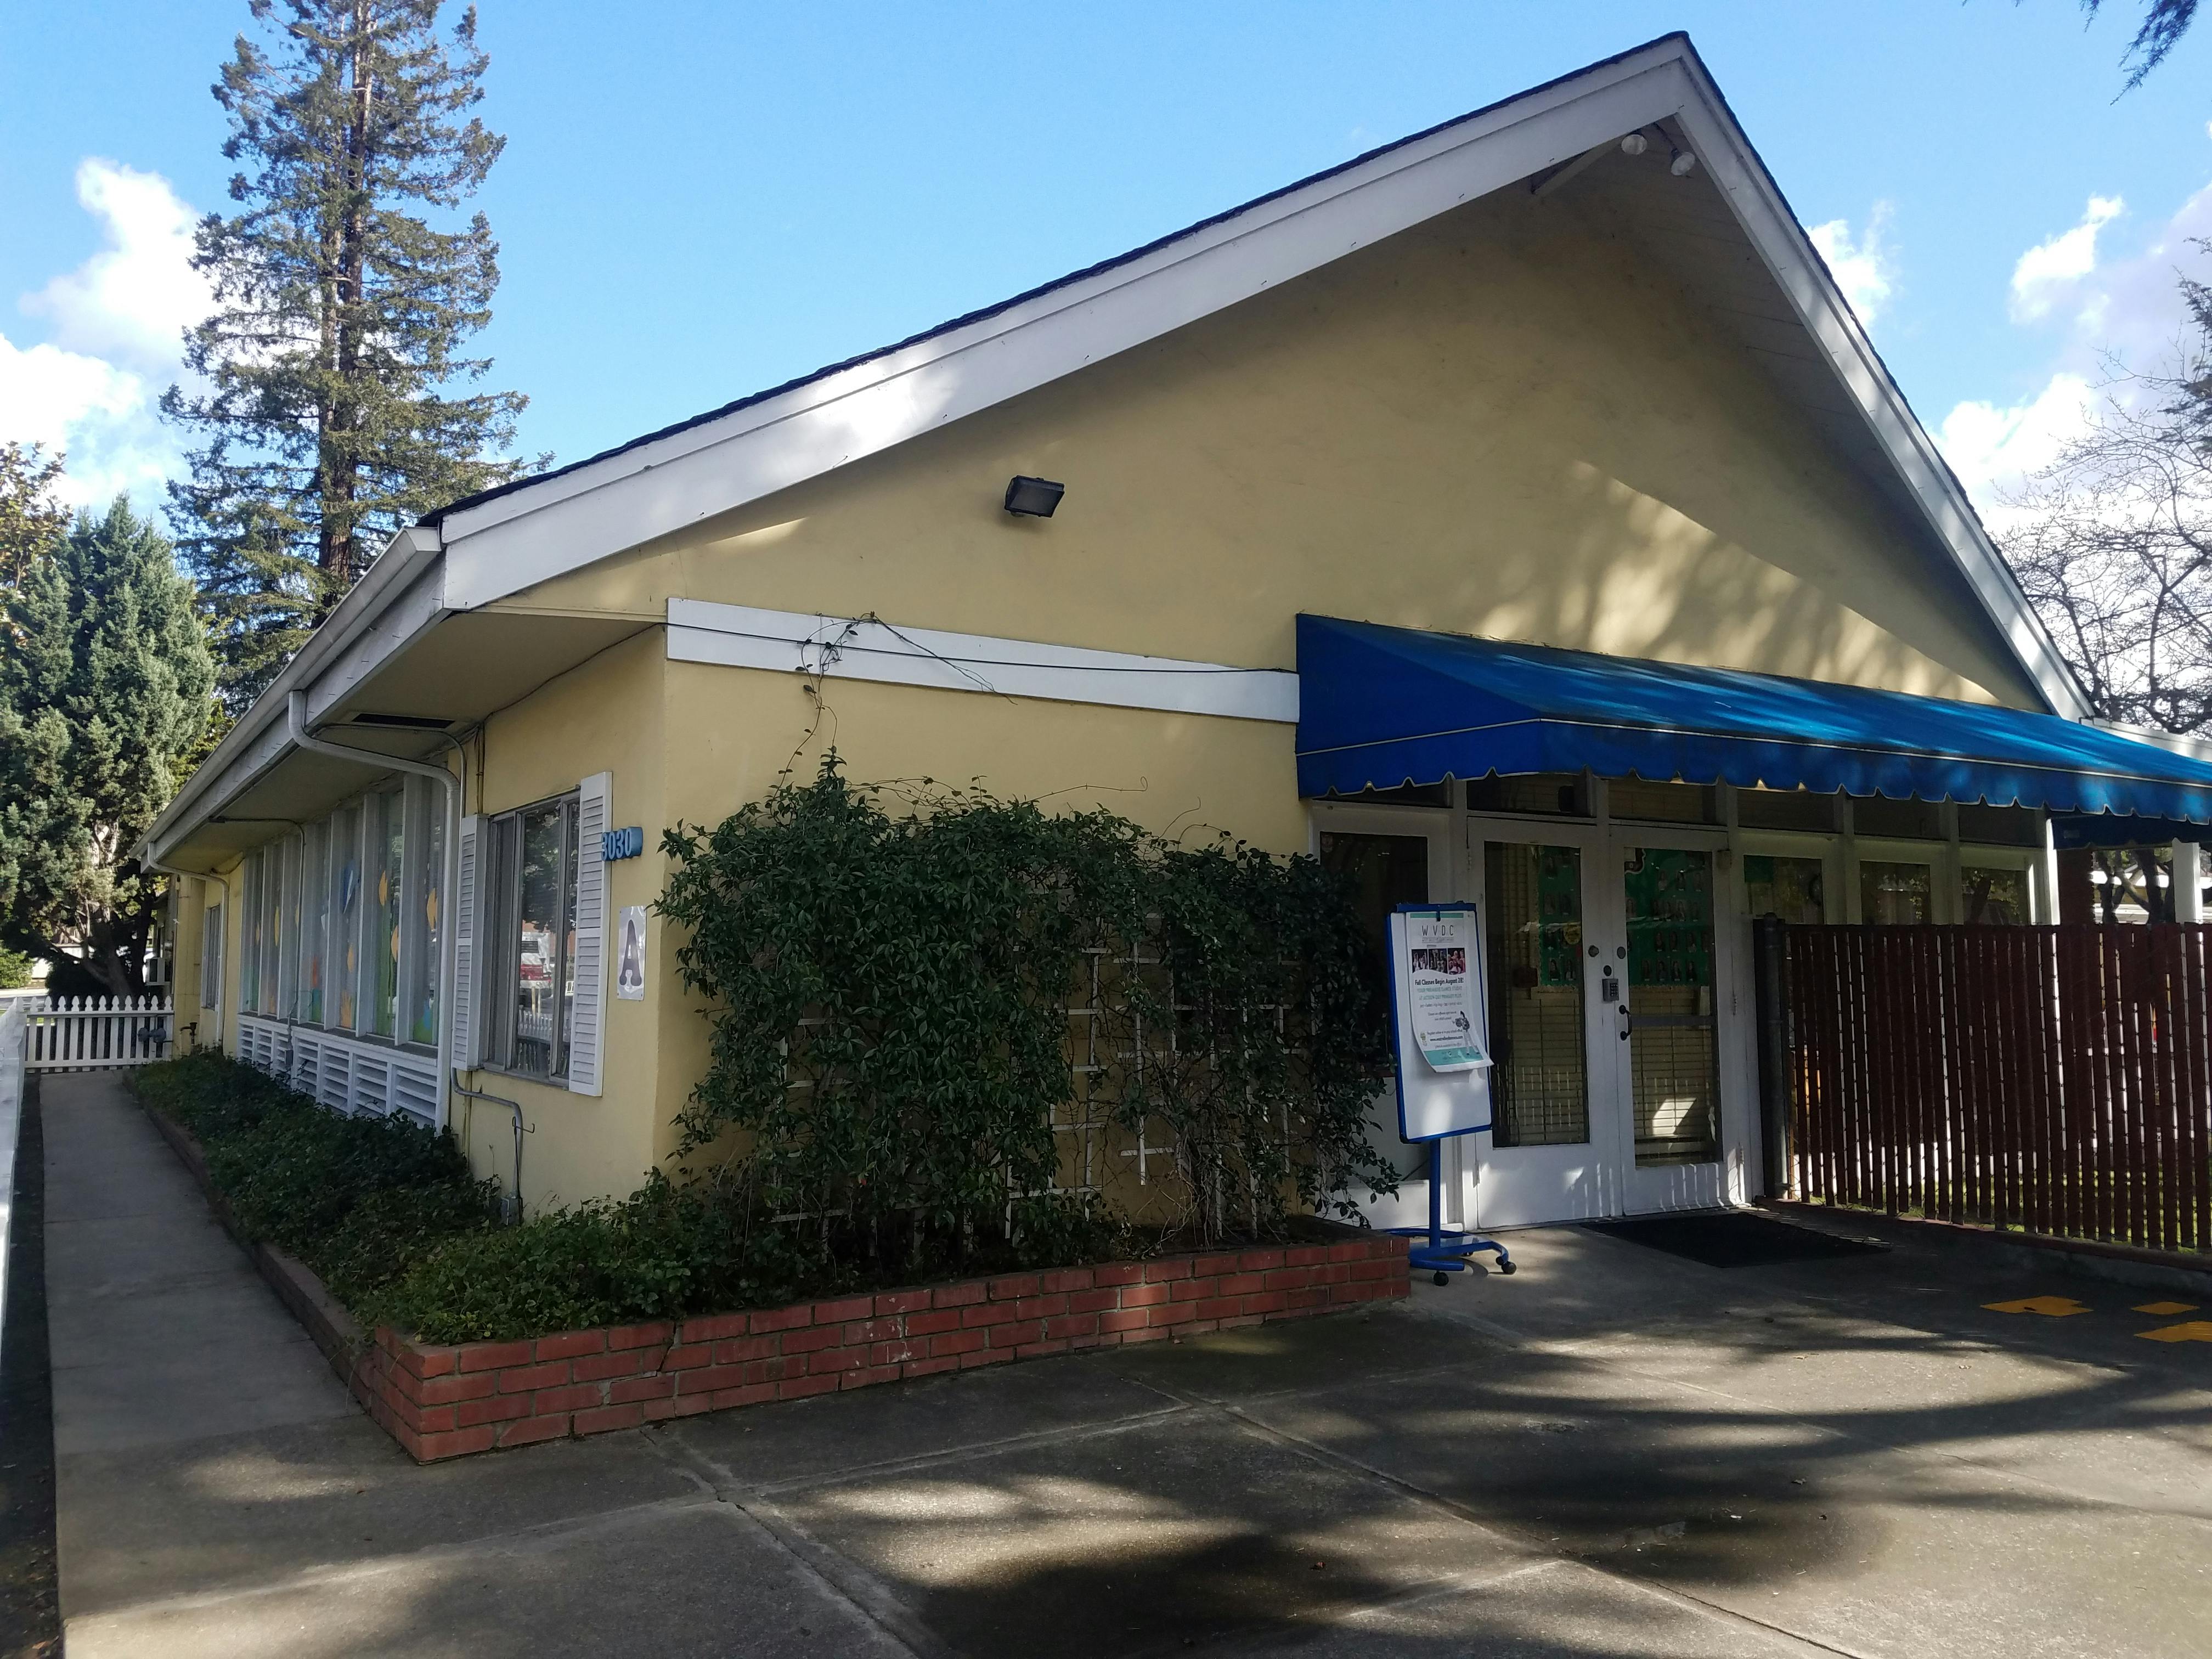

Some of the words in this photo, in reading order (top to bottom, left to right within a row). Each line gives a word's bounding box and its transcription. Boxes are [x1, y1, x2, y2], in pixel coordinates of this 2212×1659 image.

[601, 827, 632, 861] 3030
[1422, 924, 1454, 936] WVDC
[619, 918, 642, 987] A
